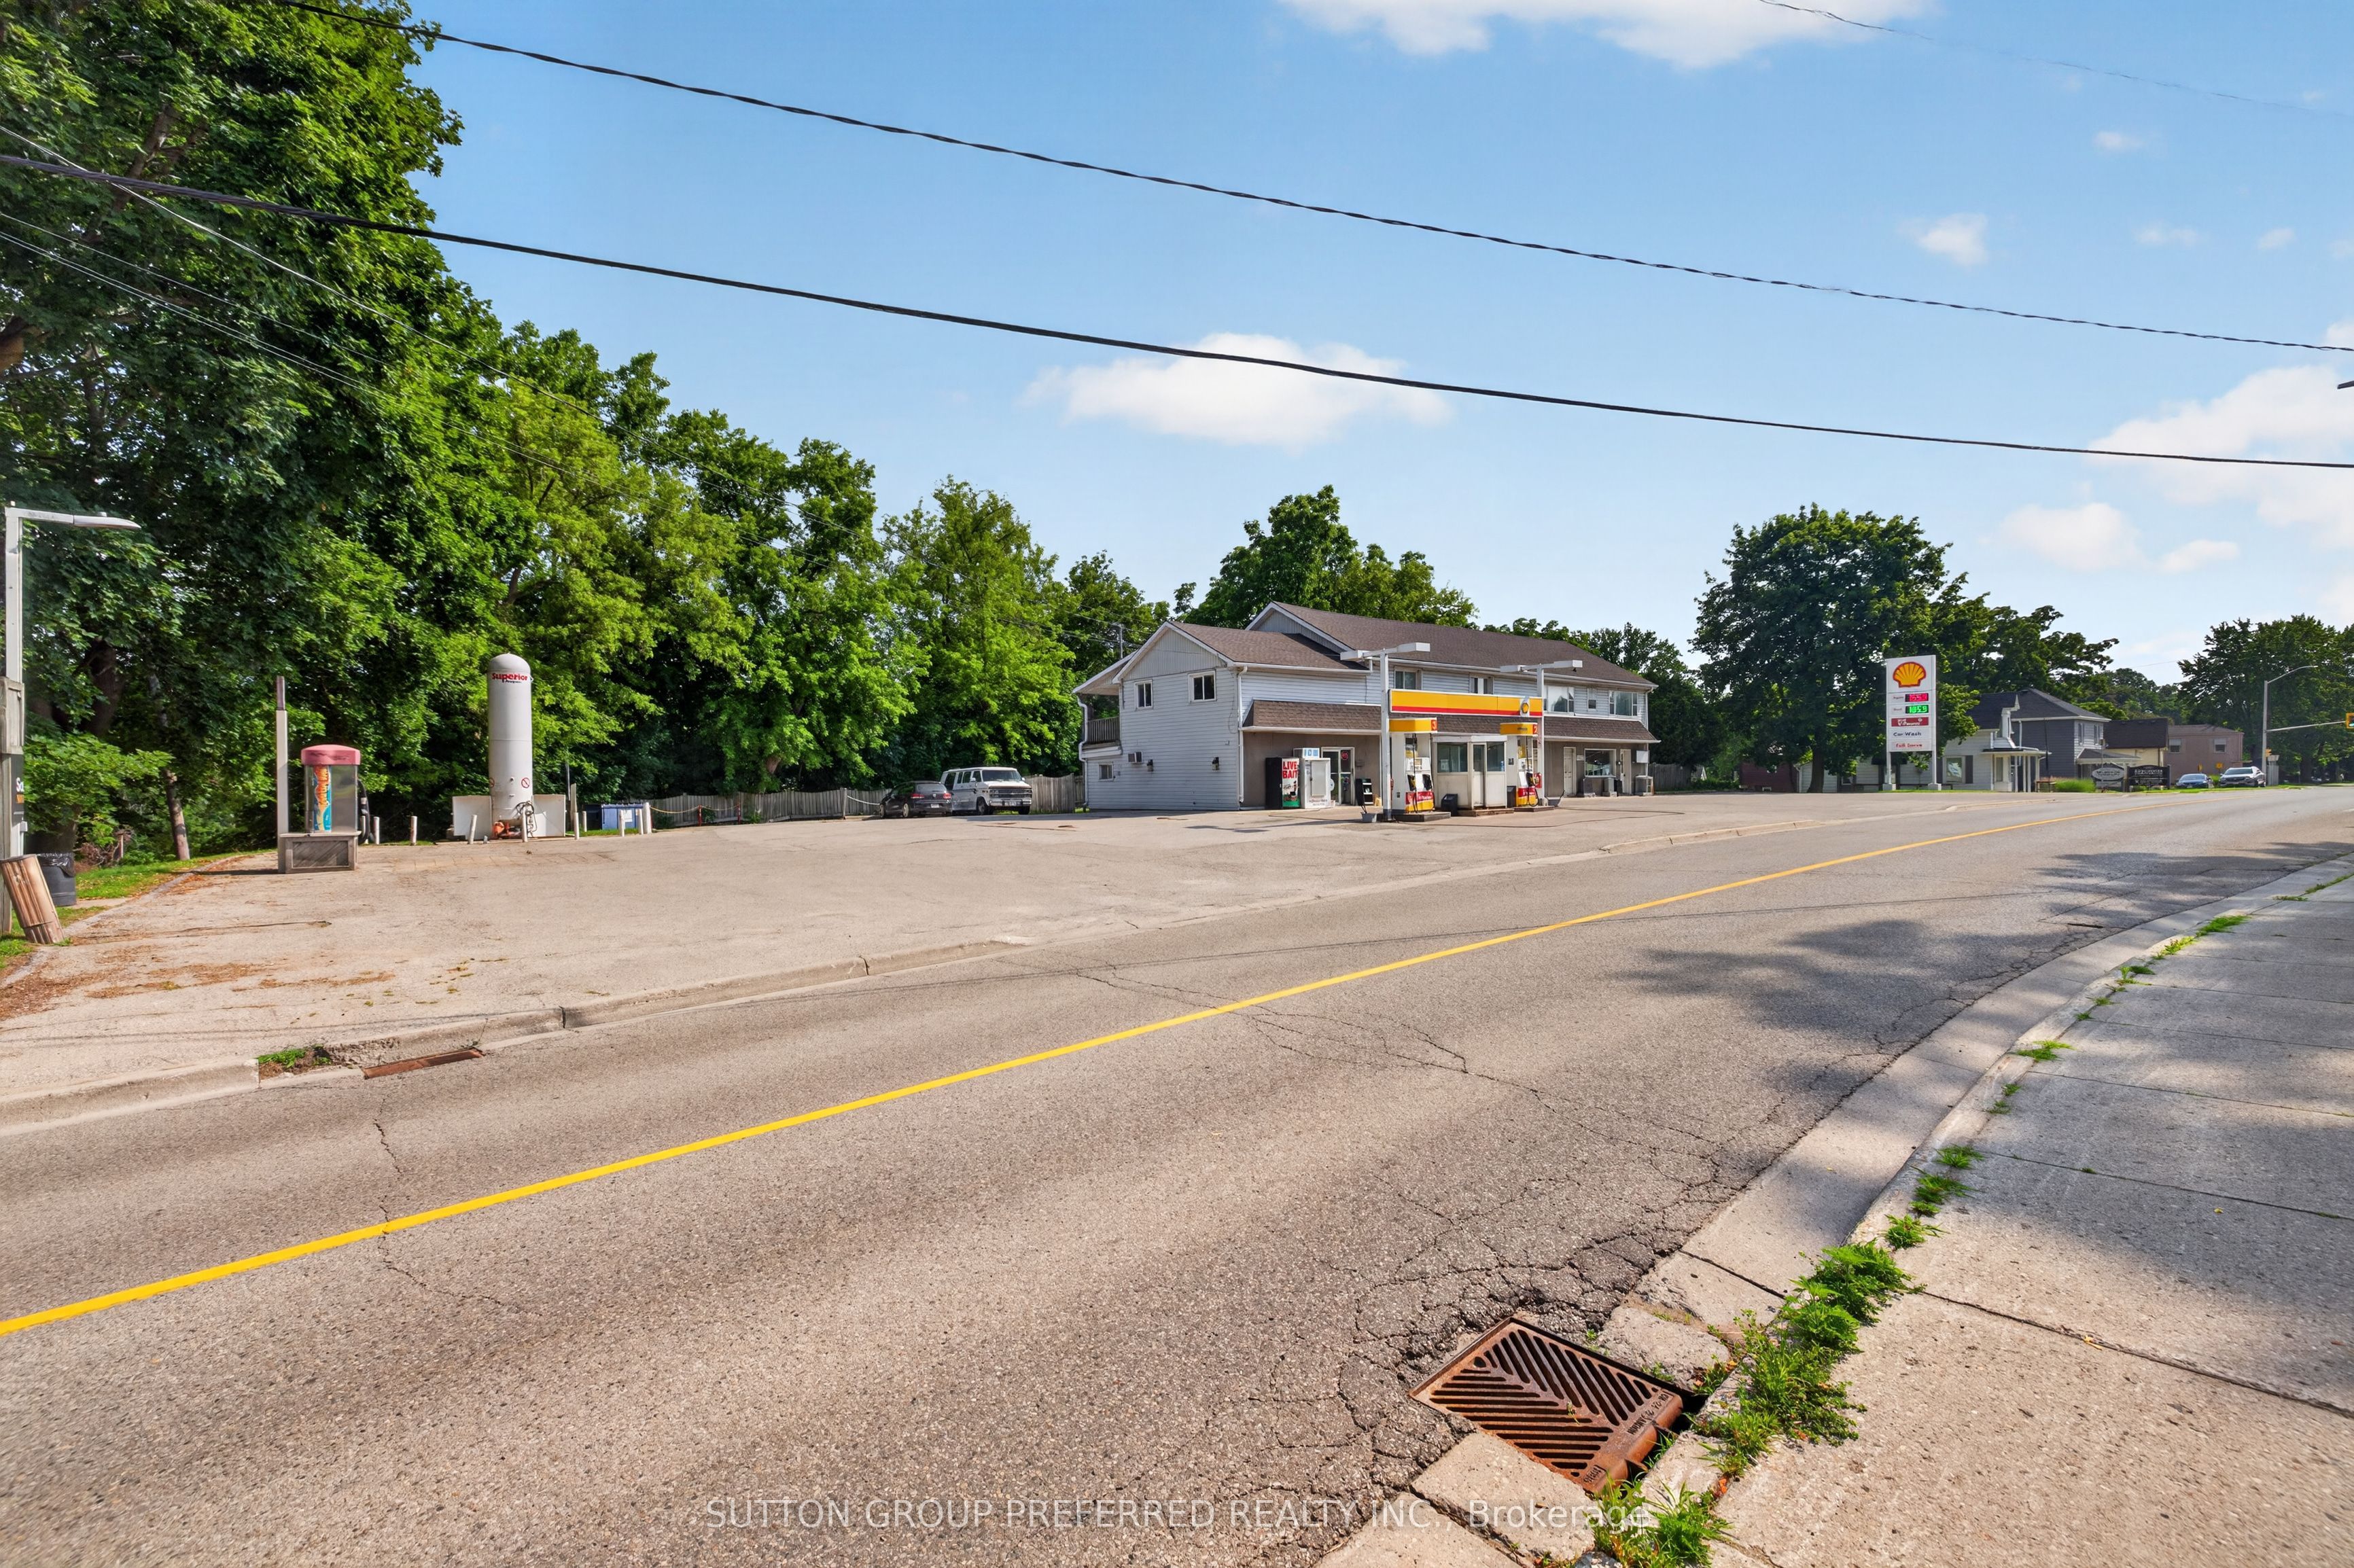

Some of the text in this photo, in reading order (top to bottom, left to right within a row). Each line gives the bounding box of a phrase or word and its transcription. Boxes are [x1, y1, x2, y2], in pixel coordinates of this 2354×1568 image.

[492, 673, 528, 683] Superior
[1283, 761, 1297, 770] LIVE
[1282, 770, 1299, 779] BAIT
